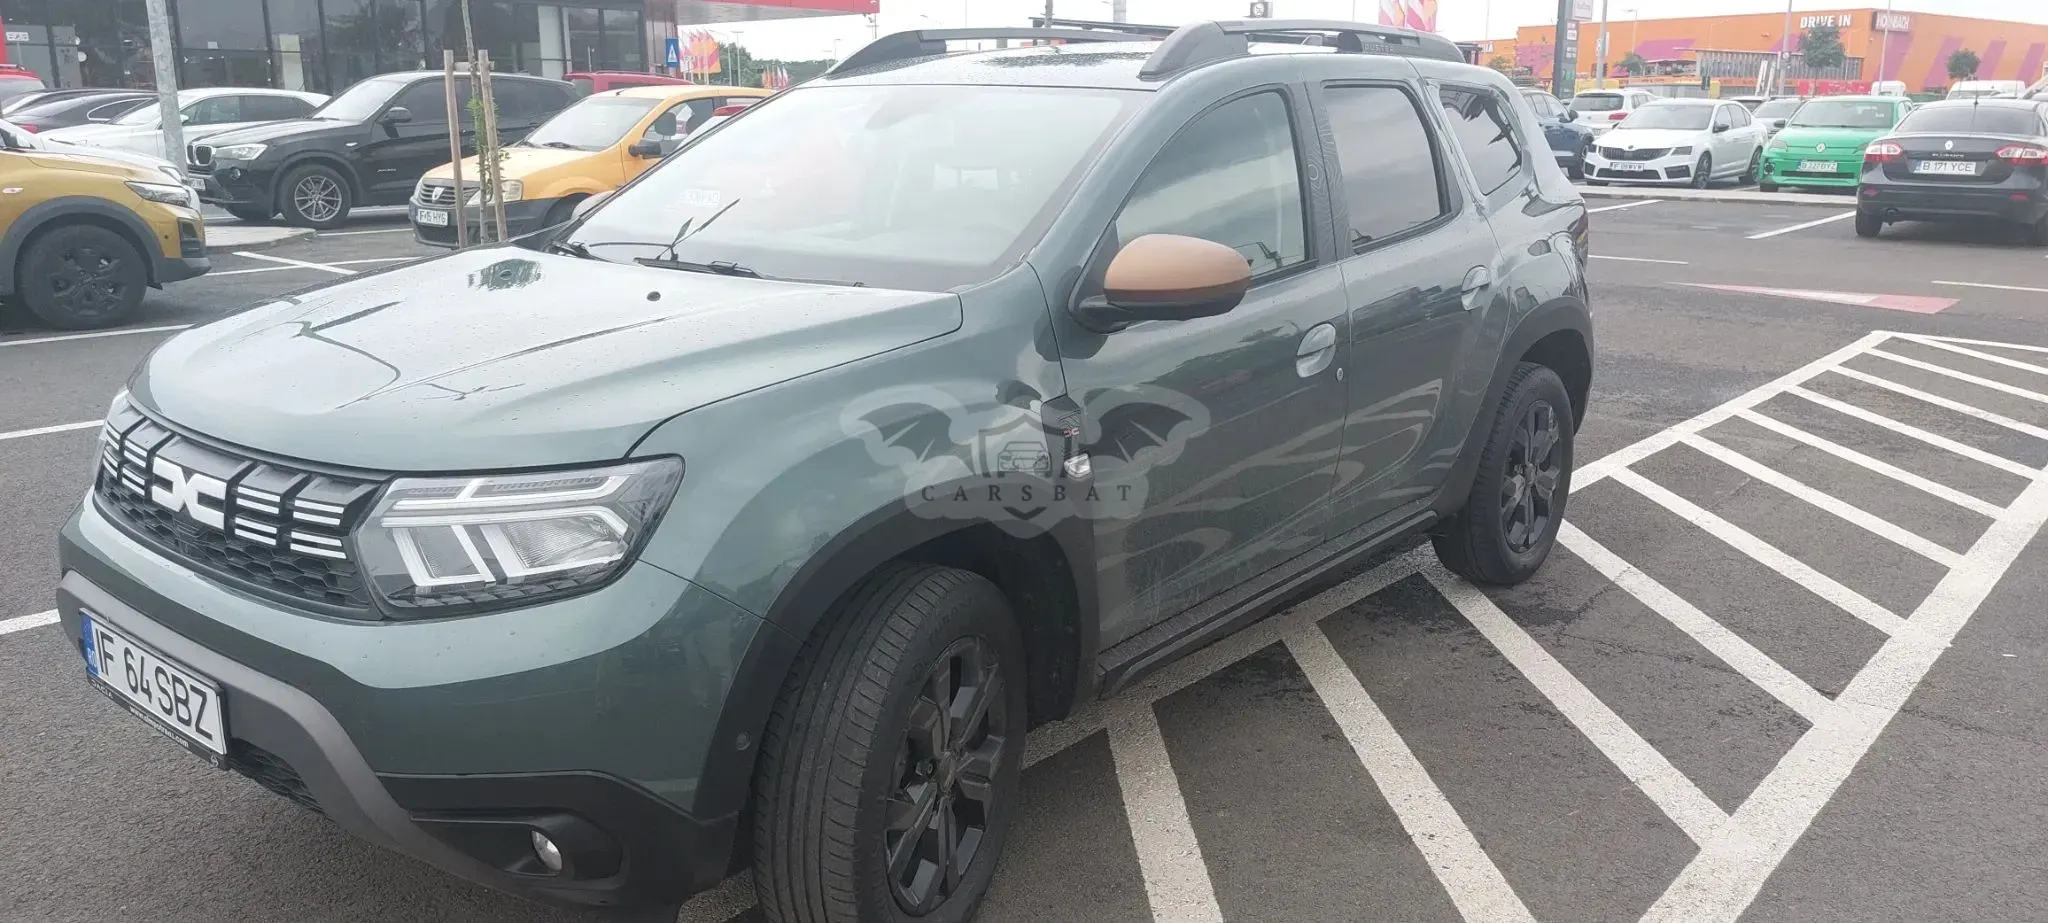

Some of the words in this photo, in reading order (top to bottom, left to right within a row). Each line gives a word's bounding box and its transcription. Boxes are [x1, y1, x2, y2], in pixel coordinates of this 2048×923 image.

[1800, 15, 1836, 28] DRIVE
[1838, 13, 1852, 27] IN
[1922, 161, 1931, 171] B
[1934, 161, 1947, 171] 171
[1950, 161, 1972, 172] YCE
[95, 627, 114, 677] IF
[123, 646, 152, 704] 64
[154, 665, 213, 741] SBZ
